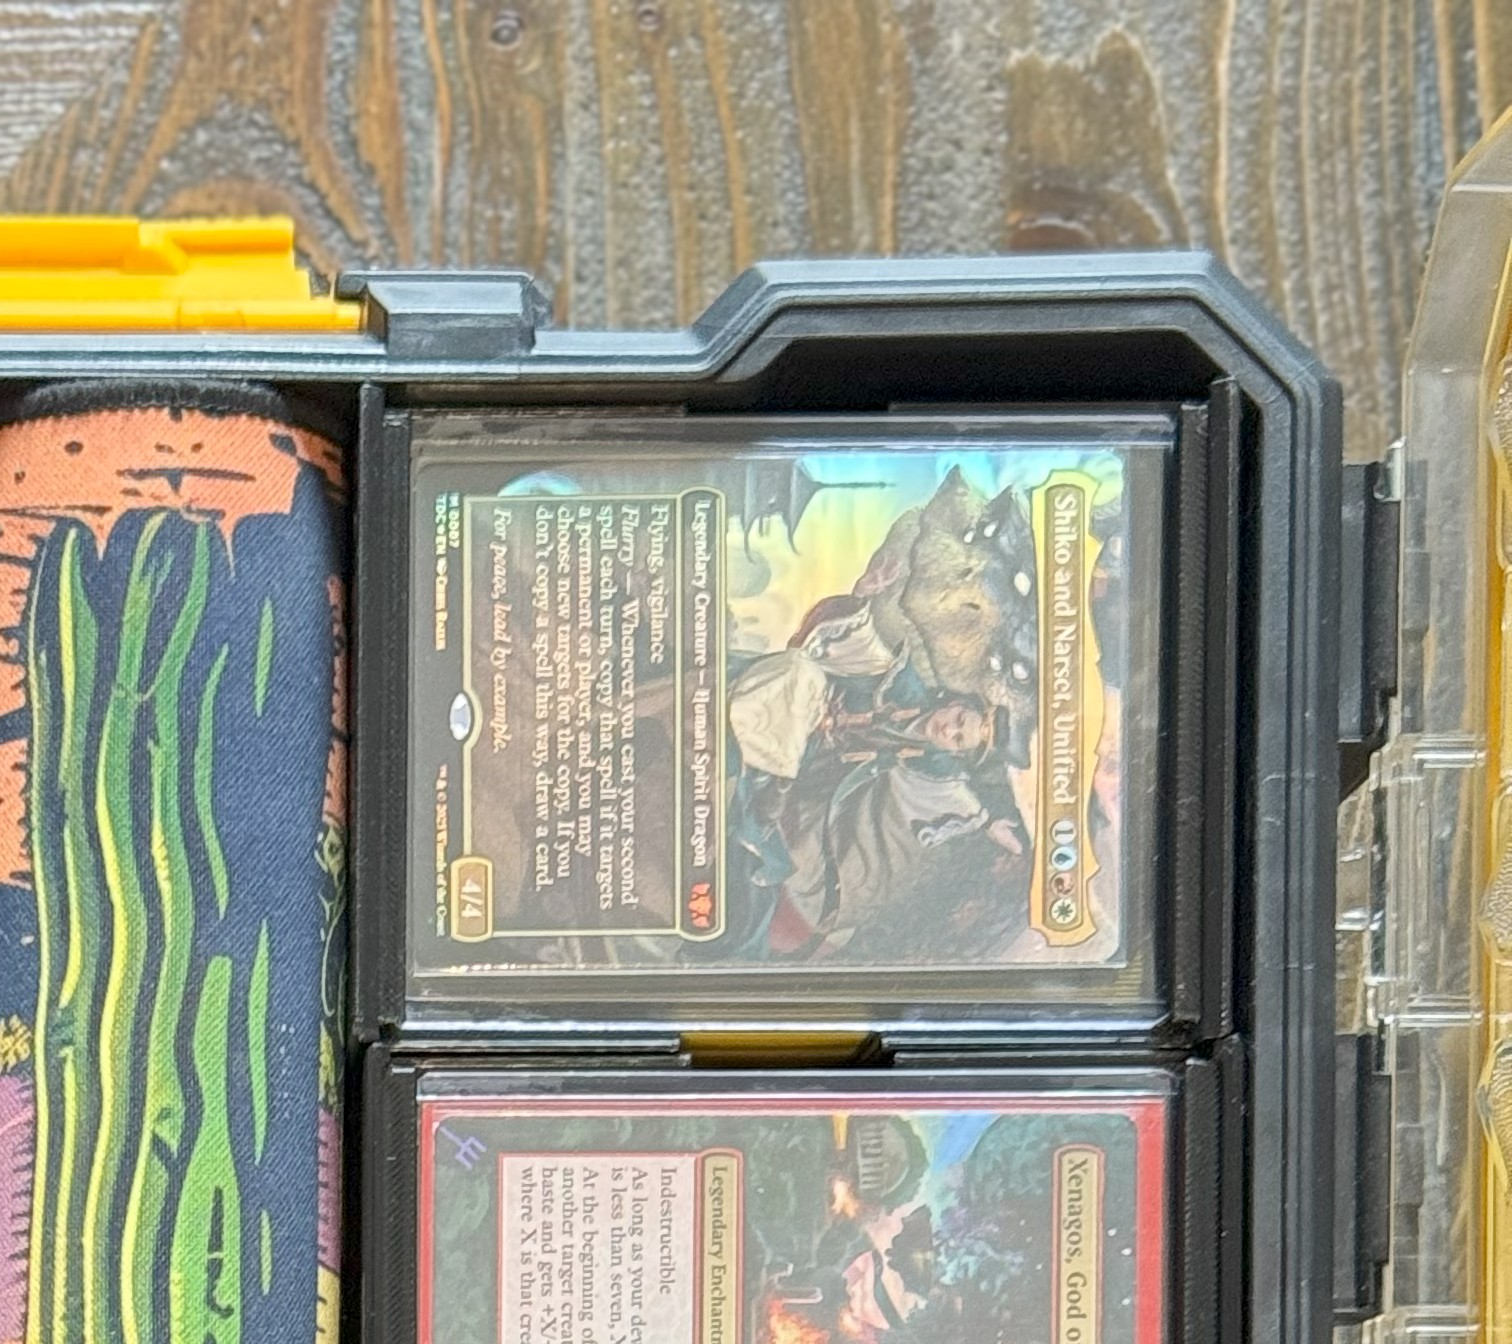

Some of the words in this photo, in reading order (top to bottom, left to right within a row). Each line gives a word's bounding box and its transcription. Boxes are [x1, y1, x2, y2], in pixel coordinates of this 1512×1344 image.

[493, 509, 511, 540] For
[618, 505, 638, 567] Flurry
[648, 505, 669, 574] Flying,
[692, 500, 712, 588] Legendary
[1053, 495, 1076, 563] Shiko
[490, 542, 507, 600] peace,
[1053, 569, 1075, 616] and
[493, 604, 511, 641] lead
[622, 600, 638, 697] Whenever
[648, 579, 668, 664] vigilance
[694, 594, 710, 666] Creature
[491, 646, 511, 670] by
[1050, 622, 1074, 707] Narset,
[490, 674, 511, 753] example.
[618, 703, 635, 738] you
[693, 690, 710, 750] Human
[621, 745, 636, 783] cast
[691, 753, 710, 801] Spirit
[1051, 715, 1075, 804] Unified
[617, 788, 635, 832] your
[690, 807, 709, 867] Dragon
[461, 879, 482, 918] 4/4
[621, 838, 638, 907] second
[632, 1167, 647, 1190] As
[629, 1198, 647, 1237] long
[660, 1167, 677, 1295] Indestructible
[708, 1166, 727, 1259] Legendary
[1064, 1159, 1088, 1263] Xenagos,
[632, 1243, 642, 1261] as
[627, 1267, 642, 1308] your
[1066, 1272, 1086, 1319] God
